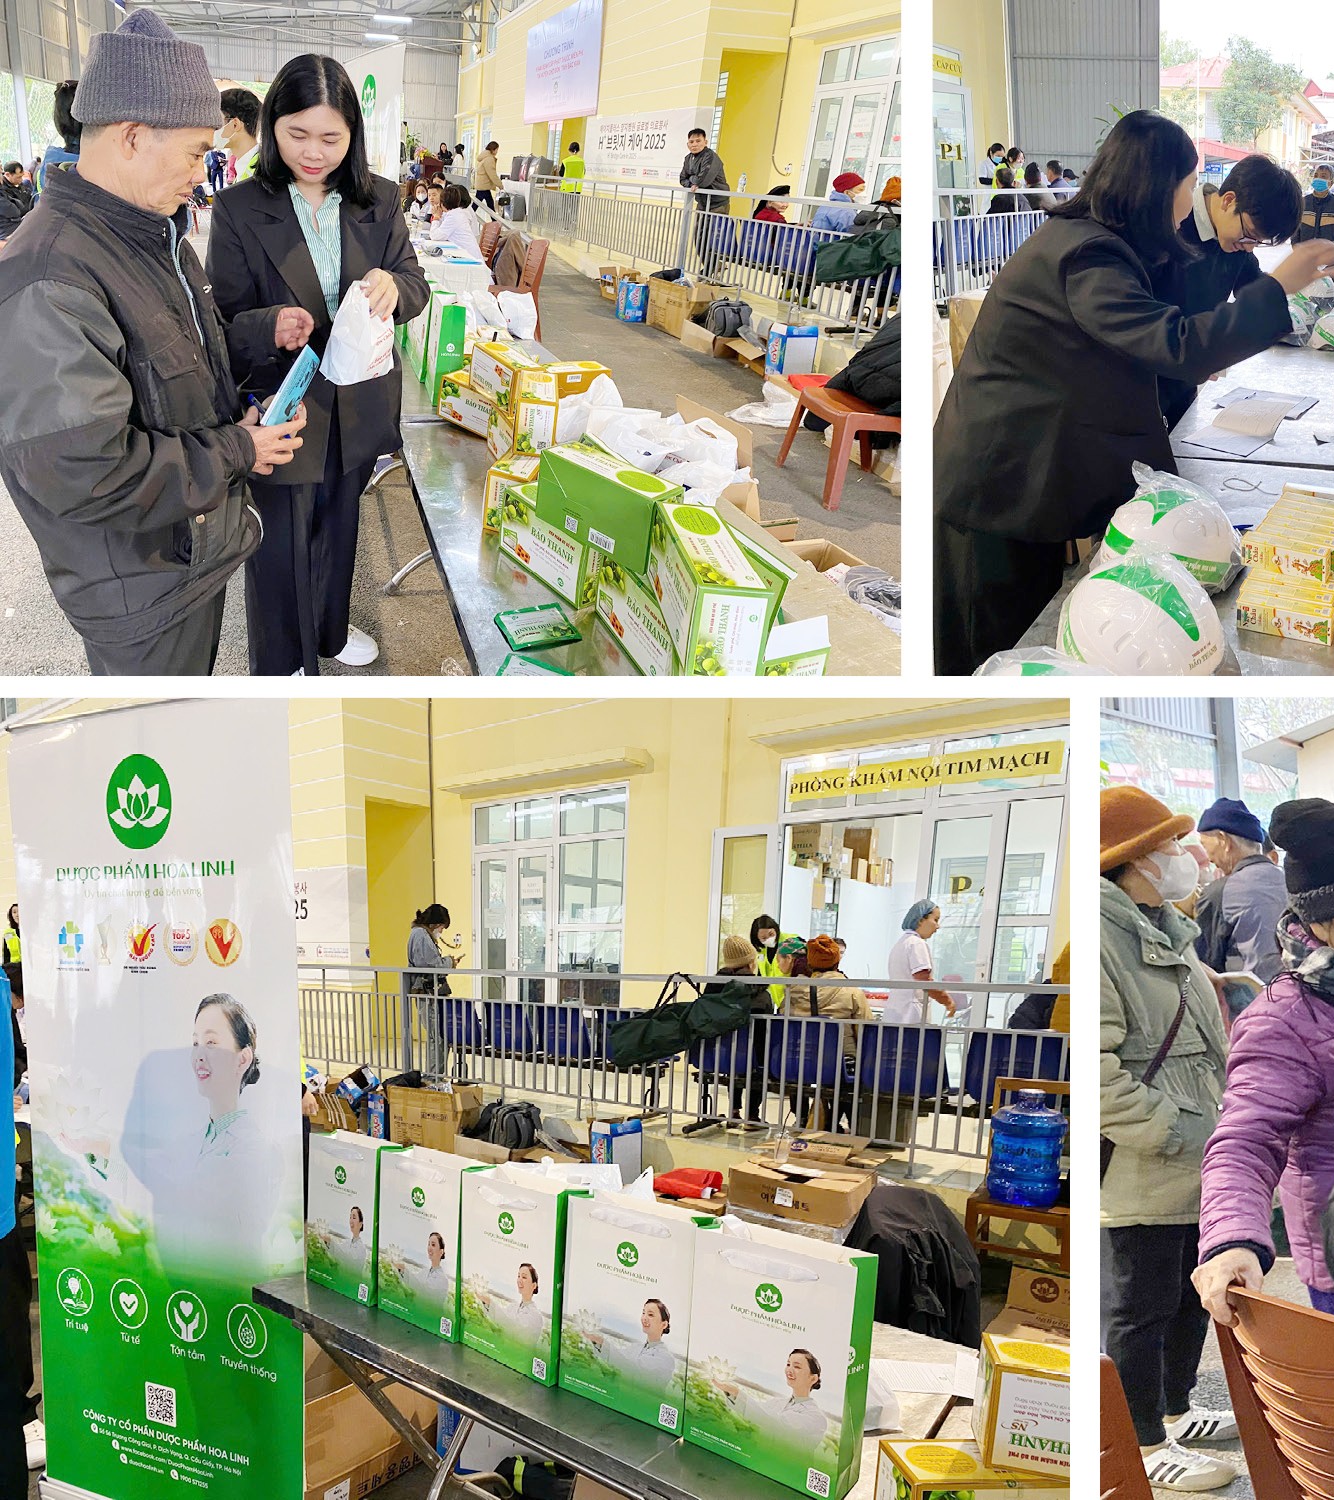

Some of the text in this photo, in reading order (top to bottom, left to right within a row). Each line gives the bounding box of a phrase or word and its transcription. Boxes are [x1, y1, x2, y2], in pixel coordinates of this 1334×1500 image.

[606, 133, 667, 151] 브릿지 케어 2025
[546, 536, 574, 565] THANH
[627, 595, 668, 651] BẢO THANH
[718, 604, 730, 632] THANH
[790, 750, 1050, 795] PHÒNG KHÁM NỘI TIM MẠCH
[56, 858, 150, 885] DƯỢC PHẨM
[65, 1318, 89, 1333] Trí tuệ
[120, 1332, 141, 1345] Từ tế
[169, 1344, 206, 1361] Tận tâm
[220, 1355, 277, 1383] Truyền thống
[83, 1408, 250, 1467] CÔNG TY CỔ PHẦN DƯỢC PHẨM HOA LINH
[179, 1473, 192, 1484] 1900
